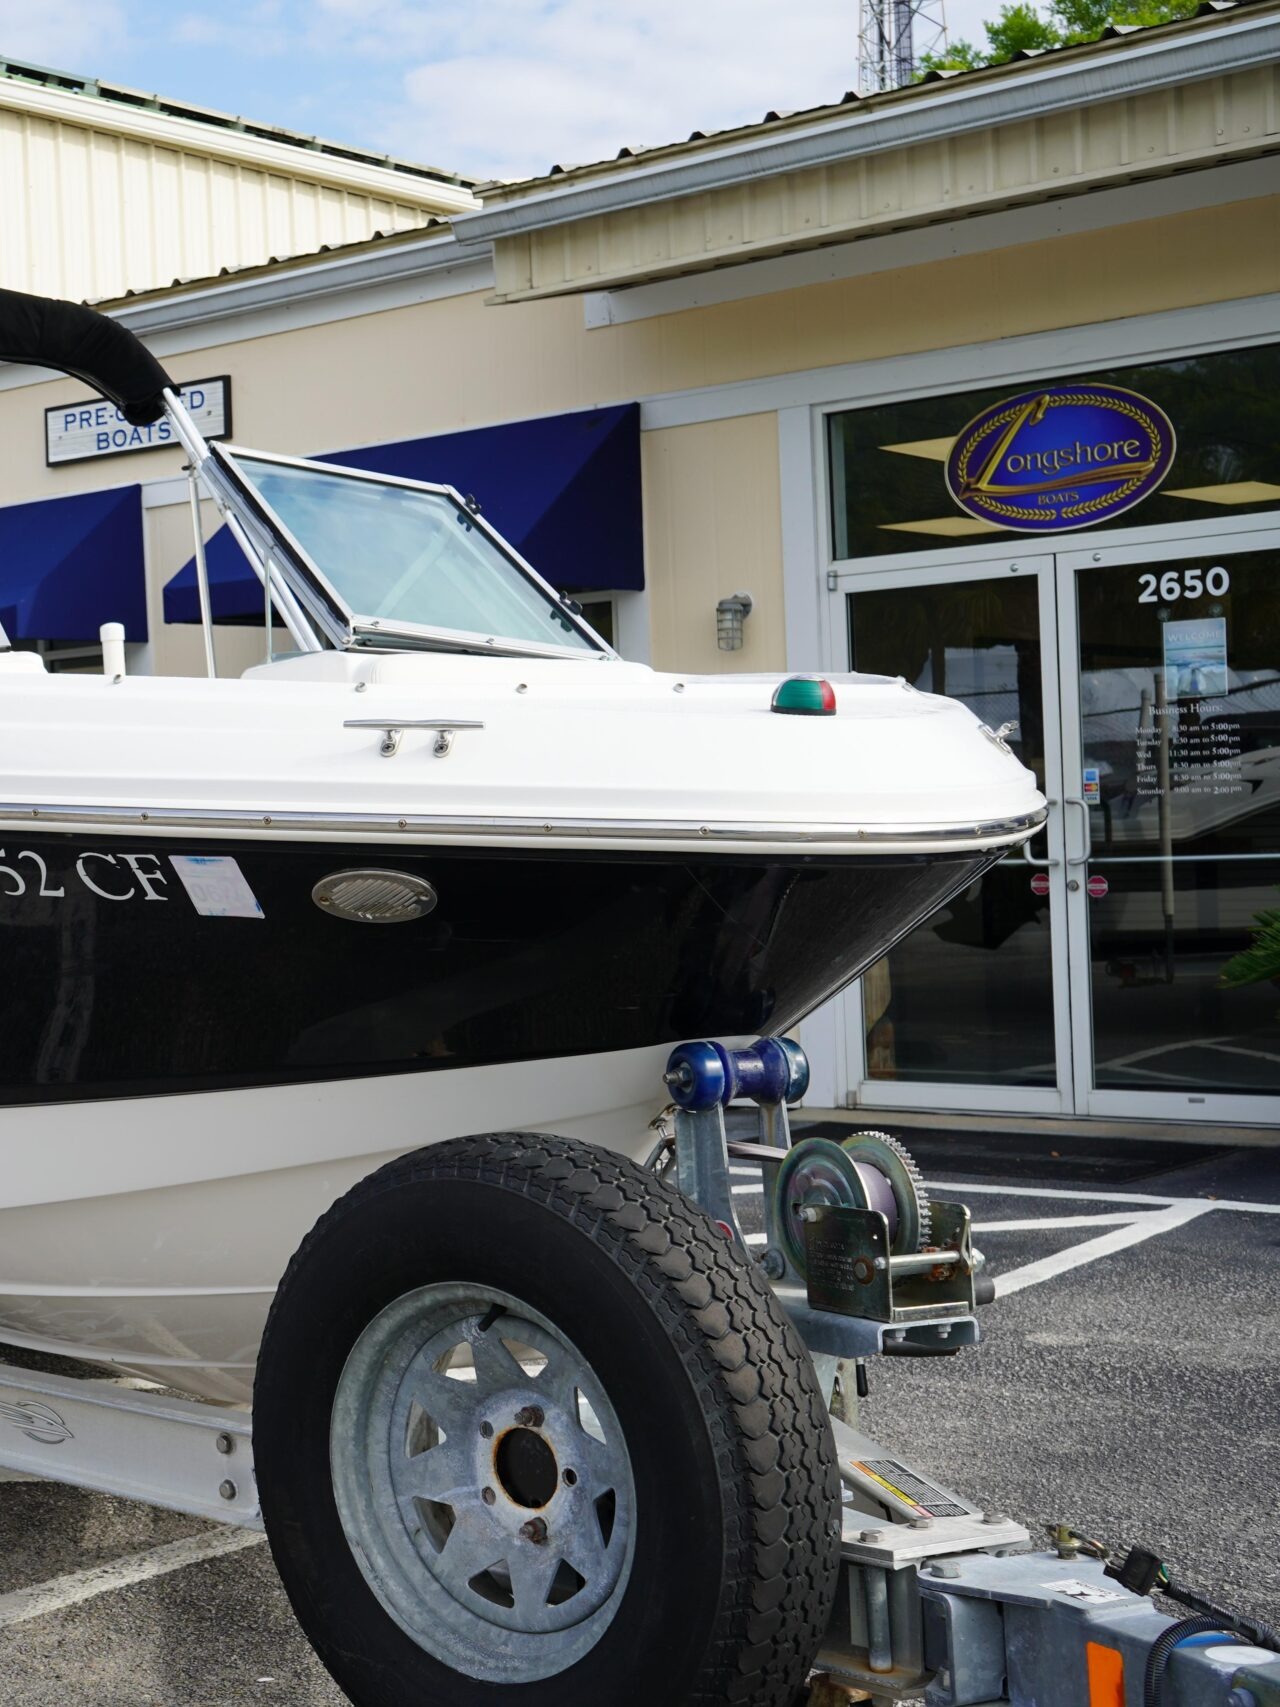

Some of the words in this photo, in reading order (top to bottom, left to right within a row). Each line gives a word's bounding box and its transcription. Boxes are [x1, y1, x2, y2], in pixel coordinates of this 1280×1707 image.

[97, 421, 171, 451] BOATS
[959, 394, 1156, 500] Longshore
[1038, 491, 1079, 505] BOATS
[1138, 566, 1230, 604] 2650
[1148, 704, 1188, 716] Business
[1190, 703, 1223, 713] Hours:
[1136, 763, 1156, 771] Thurs
[1136, 775, 1157, 784] Friday
[1137, 787, 1165, 795] Saturday
[76, 852, 168, 900] CF
